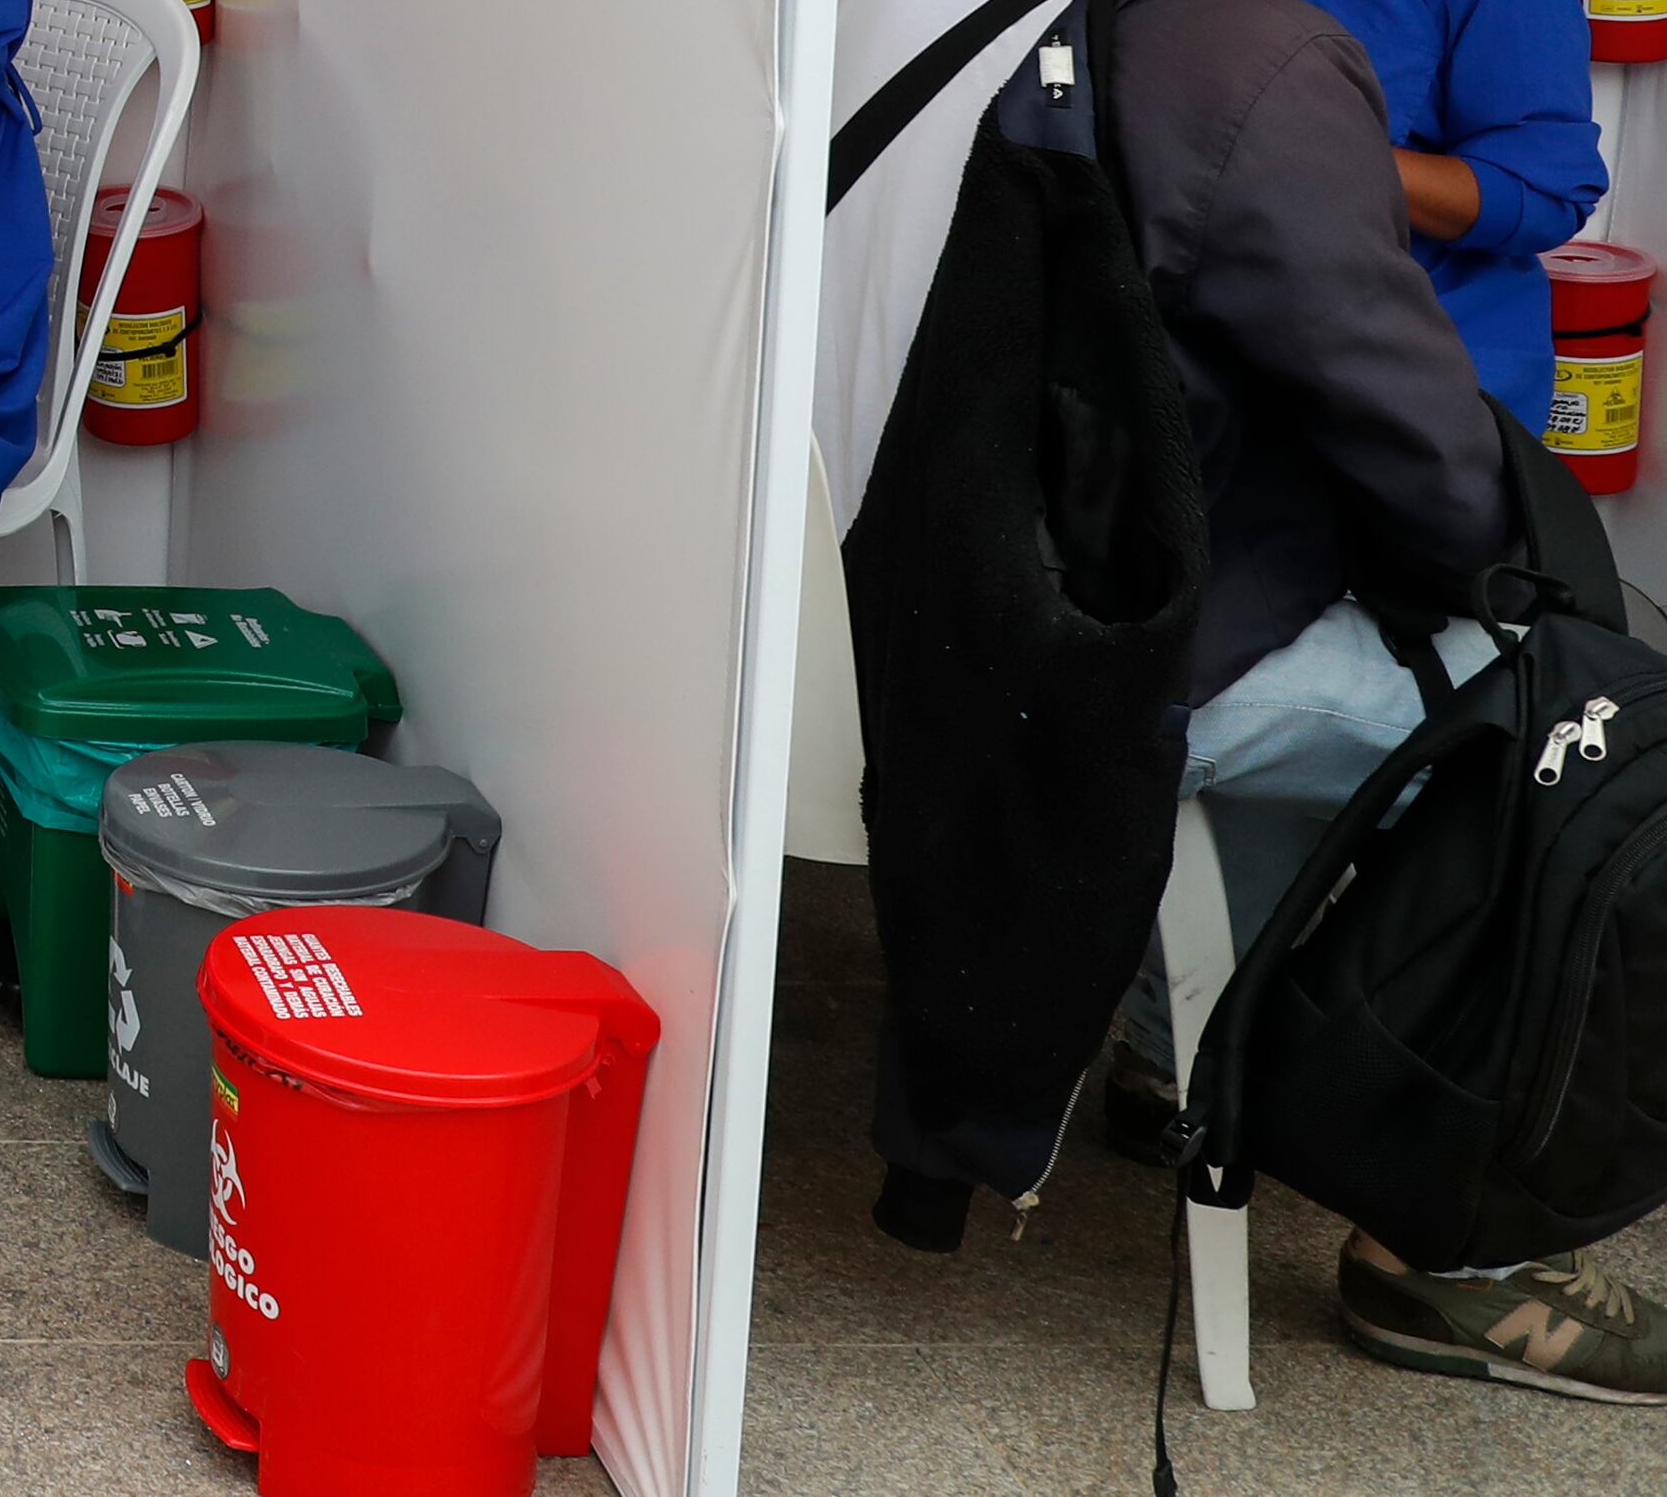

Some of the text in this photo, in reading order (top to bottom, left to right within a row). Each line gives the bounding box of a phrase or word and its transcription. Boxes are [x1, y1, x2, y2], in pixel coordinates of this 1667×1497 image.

[142, 787, 173, 818] ENVASES
[157, 783, 190, 817] BOTELLAS
[289, 968, 308, 982] SIN
[301, 933, 363, 1016] GUANTES DESECHABLES
[305, 964, 323, 975] DE
[251, 966, 291, 1019] CONTAMINADO
[298, 986, 328, 1018] AGUJAS
[210, 1230, 281, 1320] LOGICO
[1483, 1301, 1585, 1376] N
